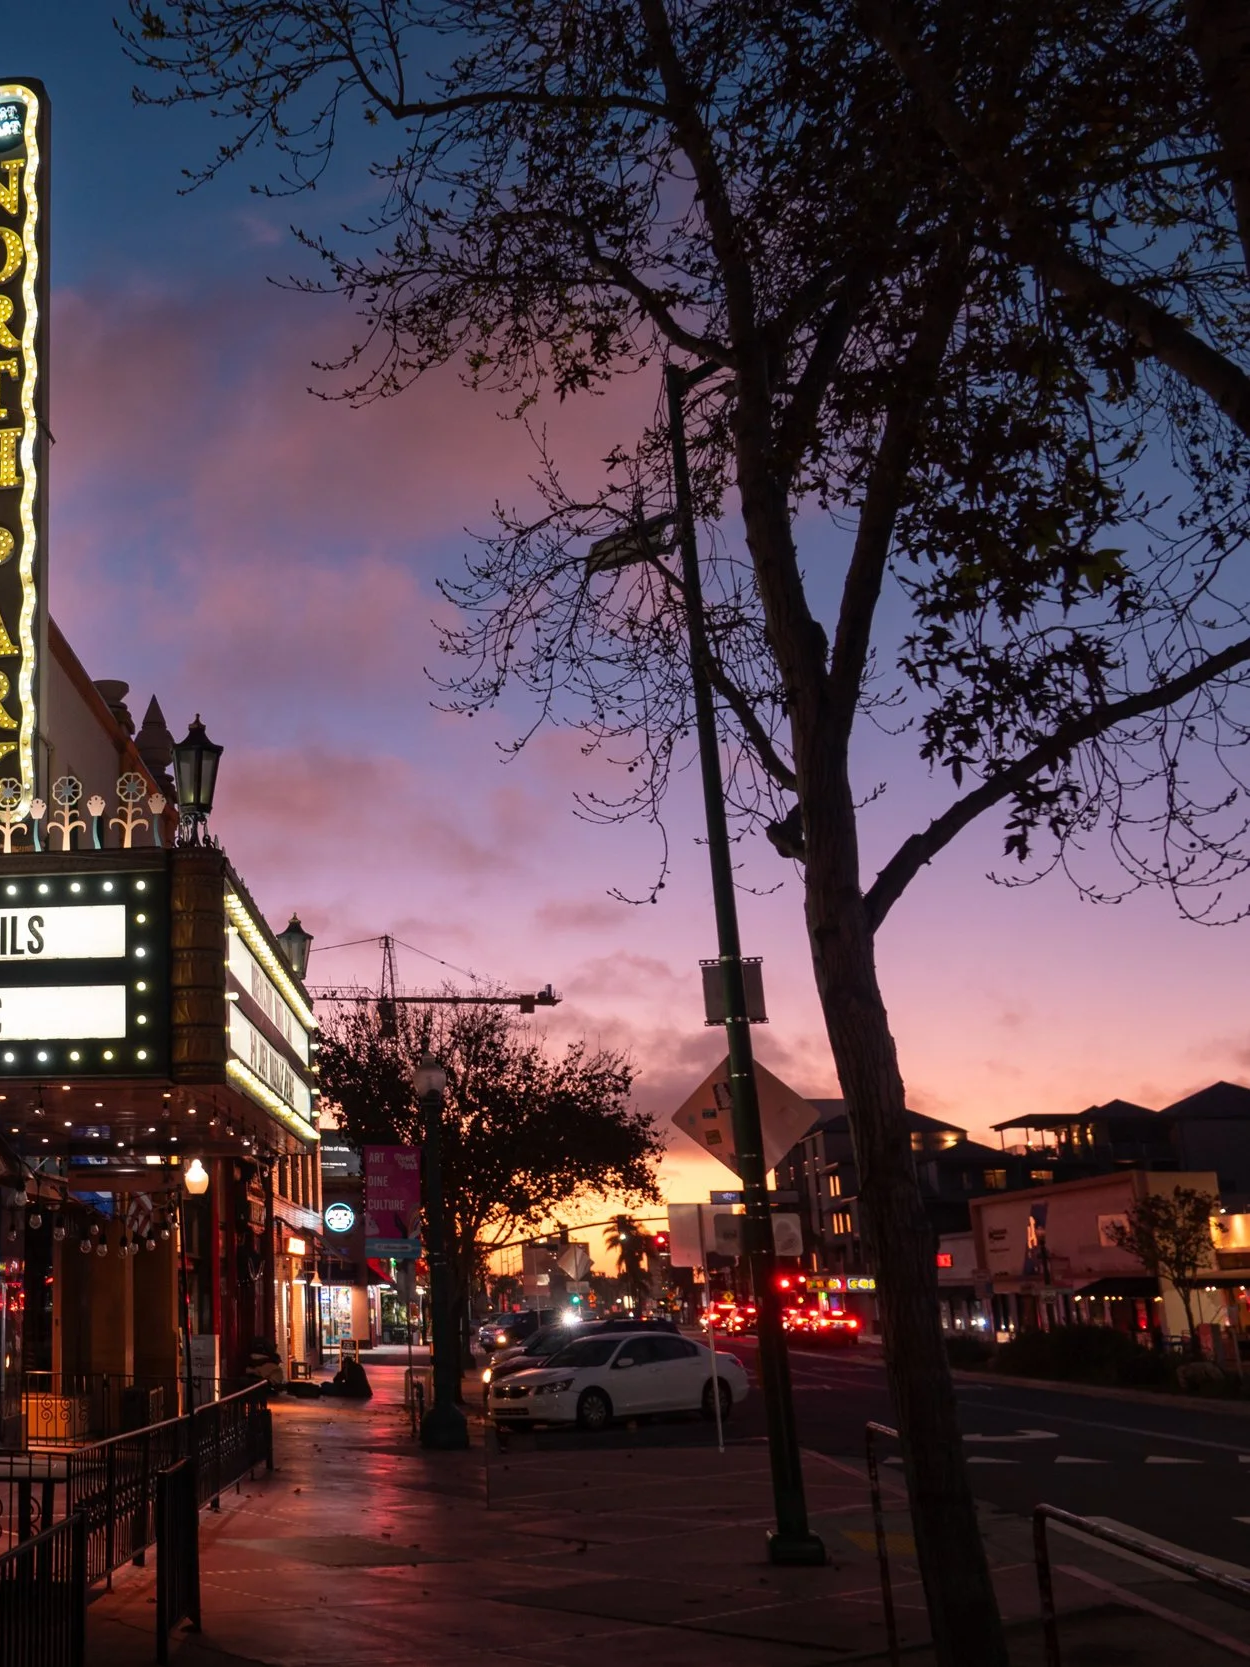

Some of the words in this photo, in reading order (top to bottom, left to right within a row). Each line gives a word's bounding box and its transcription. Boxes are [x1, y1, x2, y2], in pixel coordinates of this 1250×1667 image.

[368, 1152, 385, 1164] ART
[367, 1175, 389, 1187] DINE
[367, 1198, 405, 1211] CULTURE
